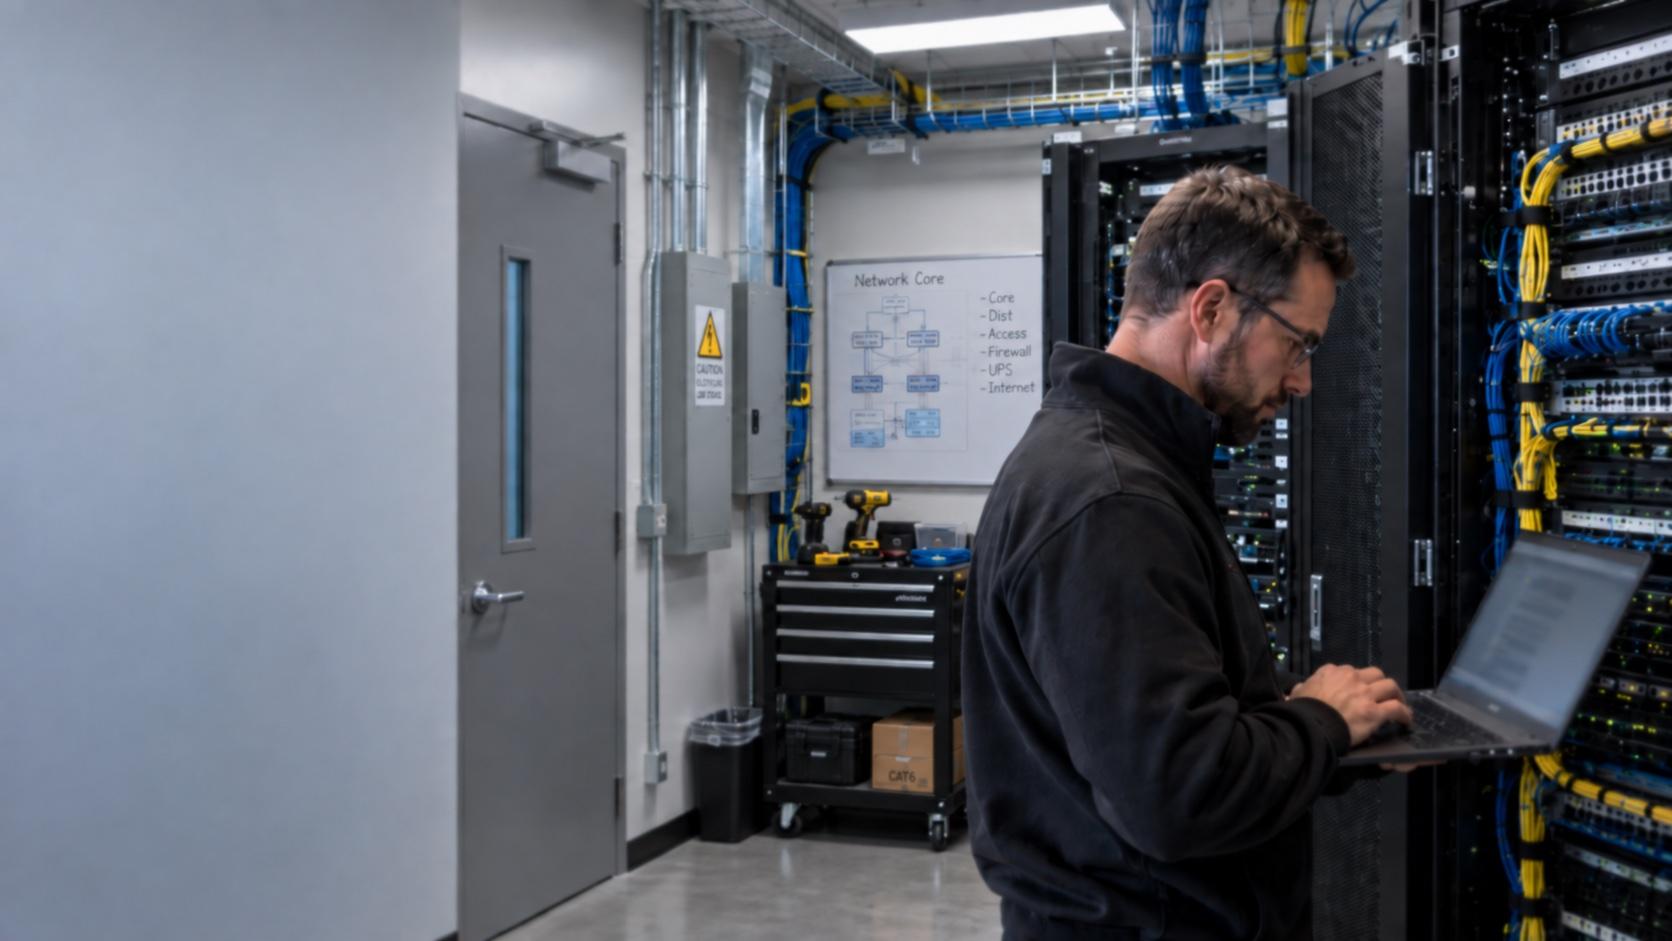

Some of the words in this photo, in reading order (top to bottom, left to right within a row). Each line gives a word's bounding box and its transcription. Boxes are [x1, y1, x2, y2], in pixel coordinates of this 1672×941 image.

[854, 273, 909, 288] Network
[914, 271, 945, 286] Core
[988, 291, 1015, 304] Core
[988, 309, 1013, 323] Dist
[987, 328, 1028, 340] Access
[988, 345, 1032, 358] Firewall
[697, 364, 723, 375] CAUTION
[989, 380, 1036, 394] Internet
[888, 769, 917, 783] CAT6
